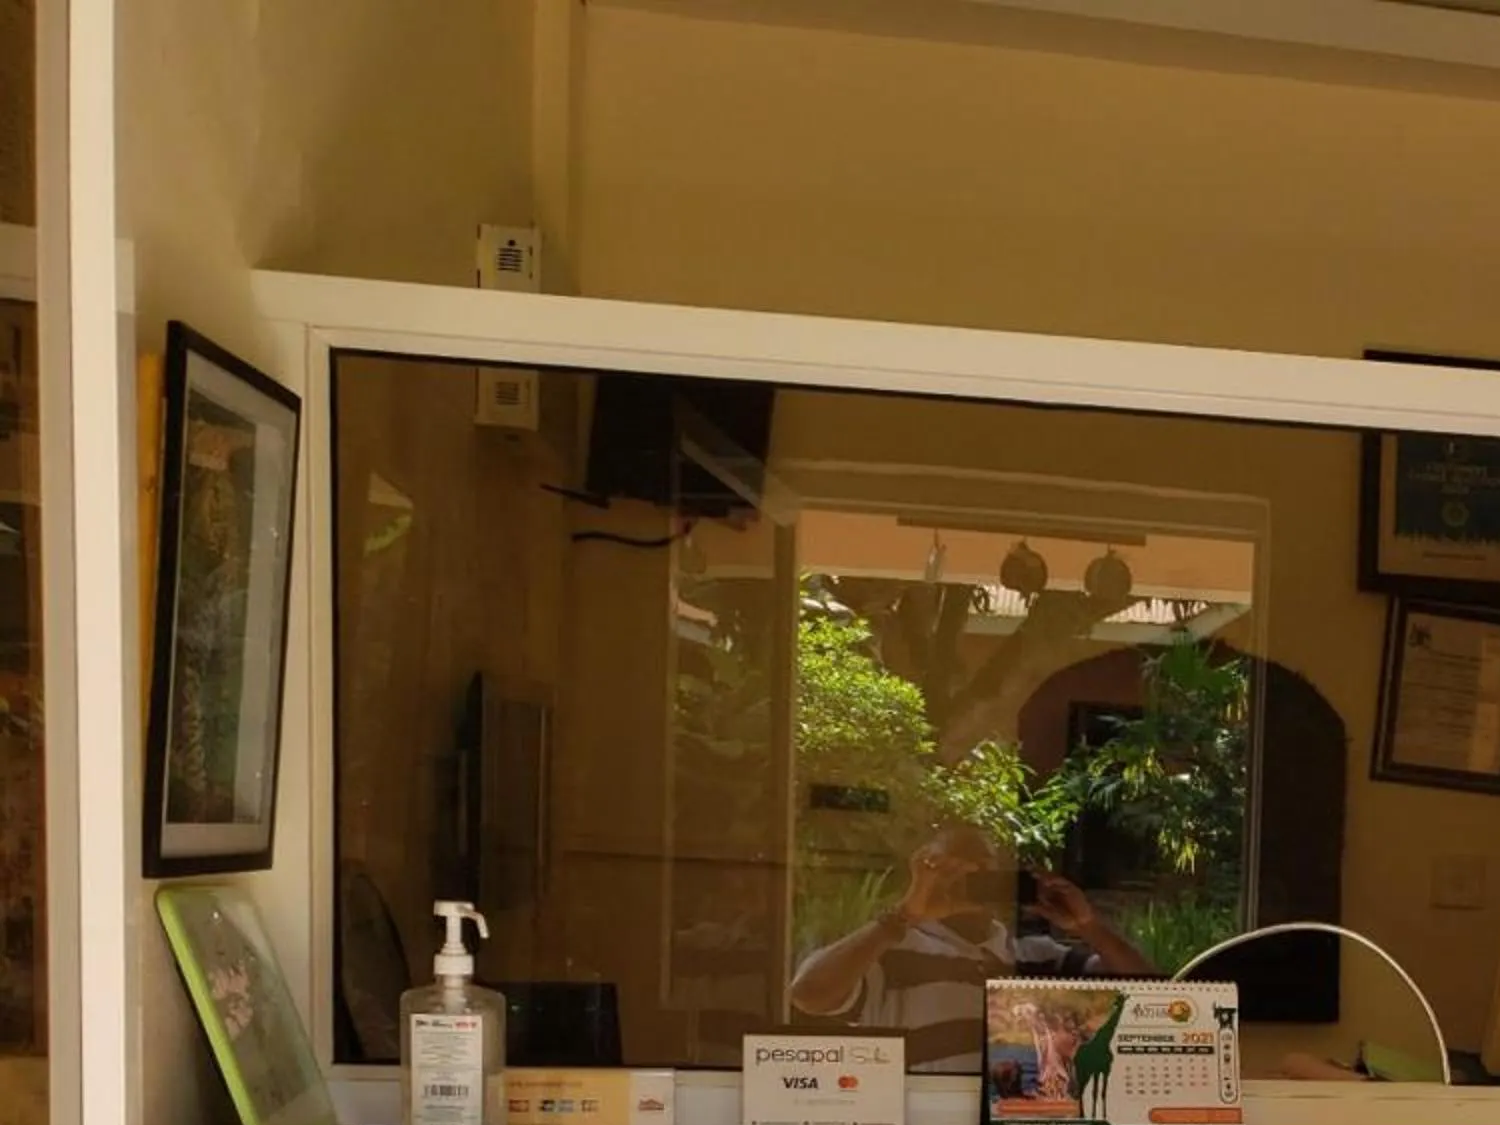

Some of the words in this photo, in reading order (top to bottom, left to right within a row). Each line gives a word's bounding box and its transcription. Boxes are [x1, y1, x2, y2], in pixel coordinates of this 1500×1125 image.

[1181, 1031, 1215, 1043] 2021
[755, 1045, 844, 1066] pesapal
[783, 1076, 819, 1089] VISA
